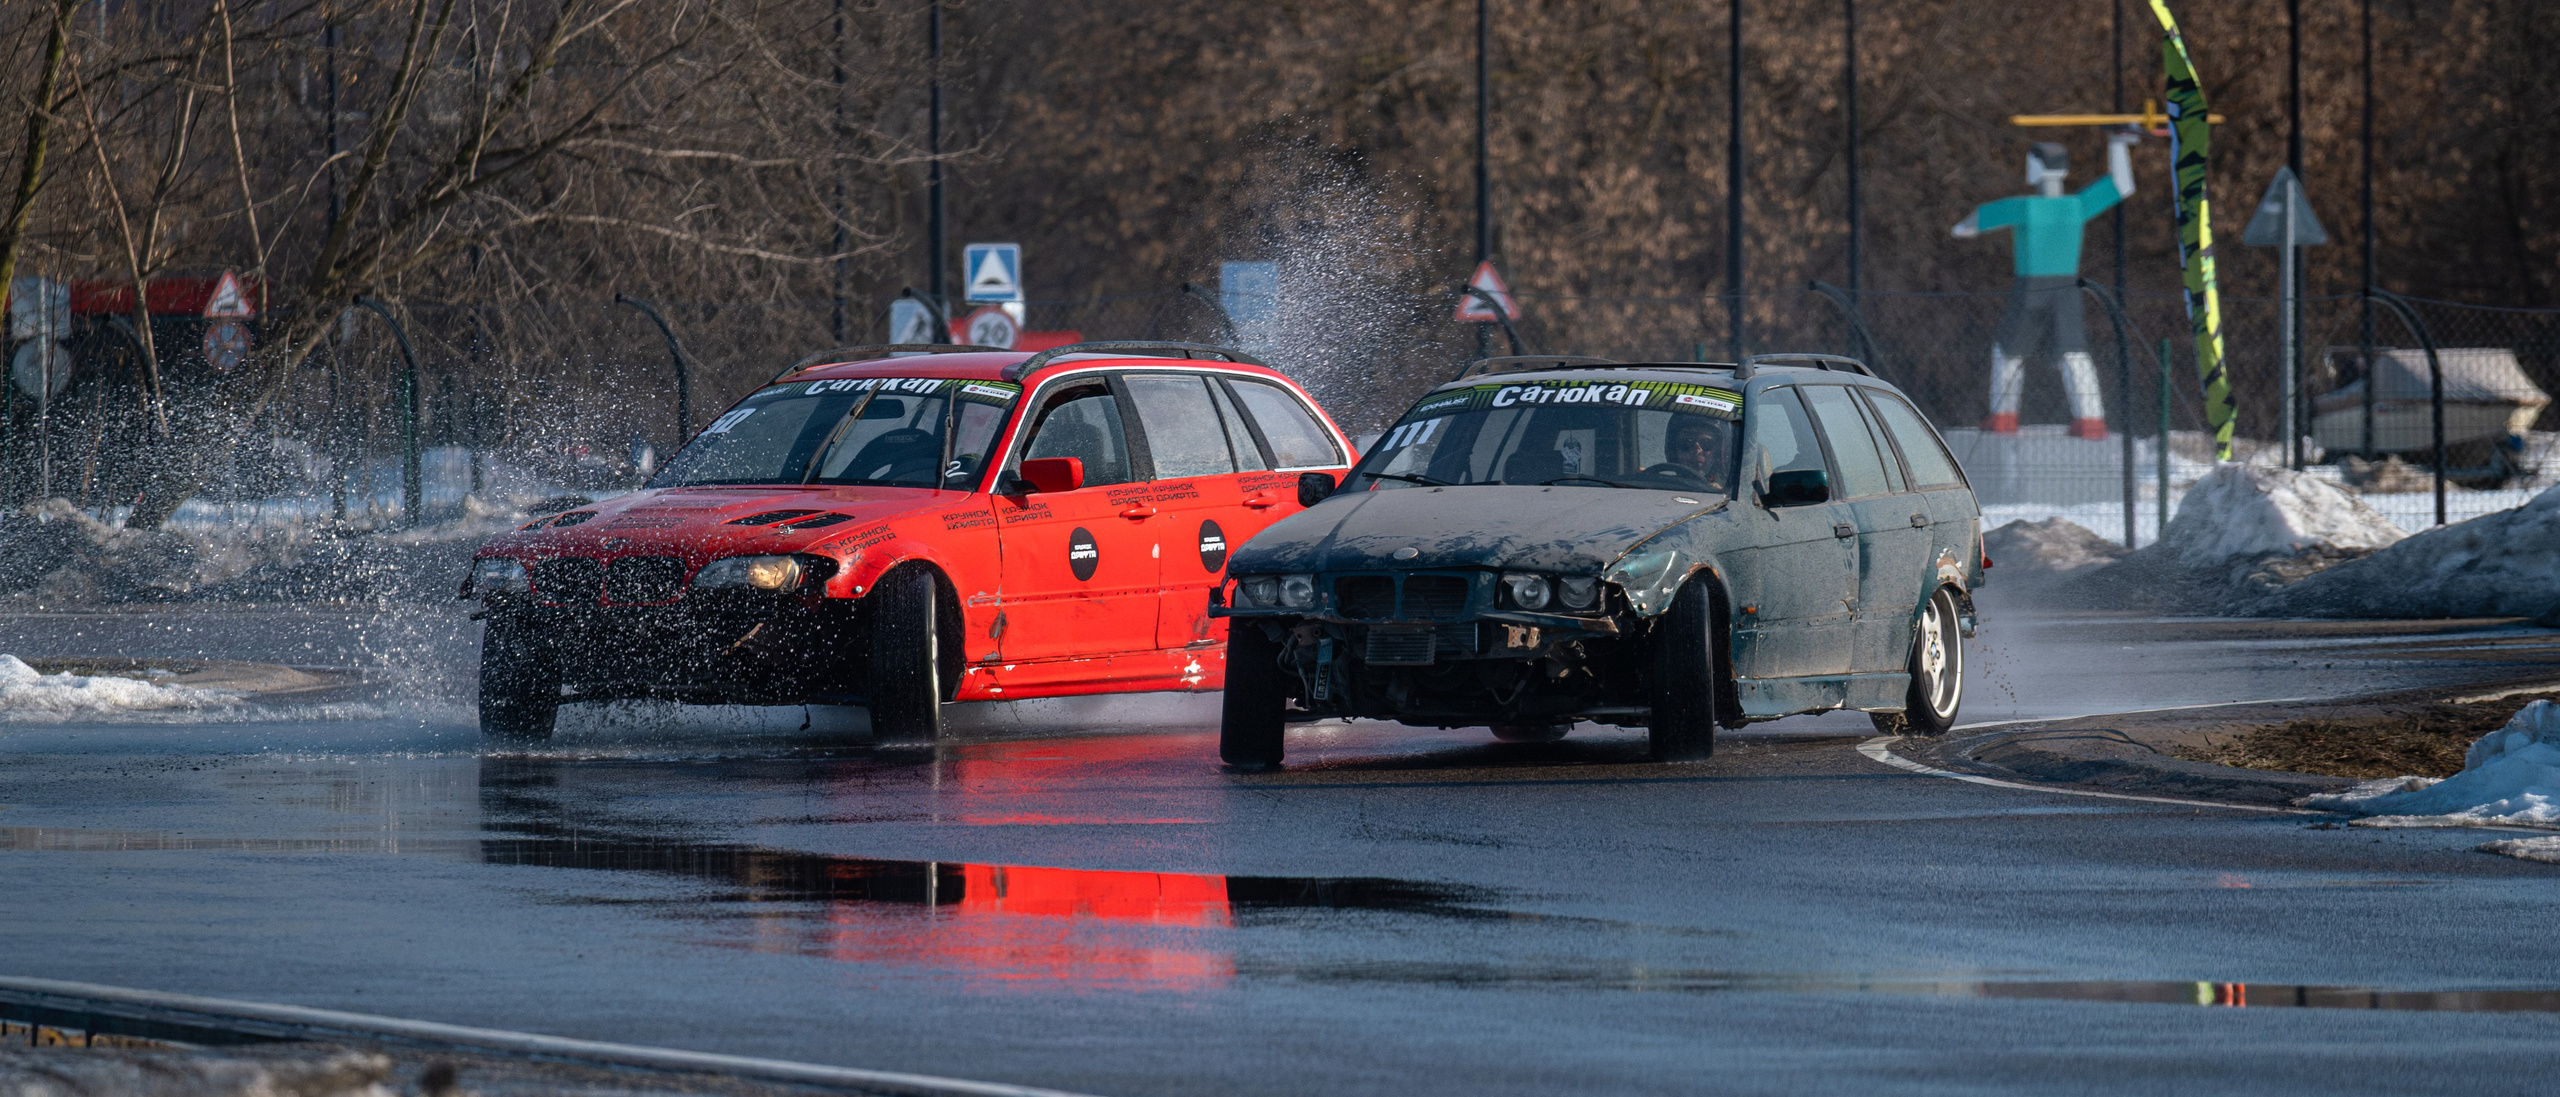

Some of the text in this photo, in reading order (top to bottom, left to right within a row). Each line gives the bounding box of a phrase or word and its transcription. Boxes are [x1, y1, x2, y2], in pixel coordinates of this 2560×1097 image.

[976, 321, 1008, 345] 20
[1382, 417, 1442, 452] 111
[1106, 483, 1194, 498] КРУЖОК КРУЖОК
[1110, 491, 1199, 506] ДРИФТА ДРИФТА
[942, 509, 991, 522] КРУЖОК
[1001, 502, 1048, 515] КРУЖОК
[1005, 511, 1052, 524] ДРИФТА
[838, 524, 891, 547] КРУЖОК
[843, 532, 896, 556] ДРИФТА
